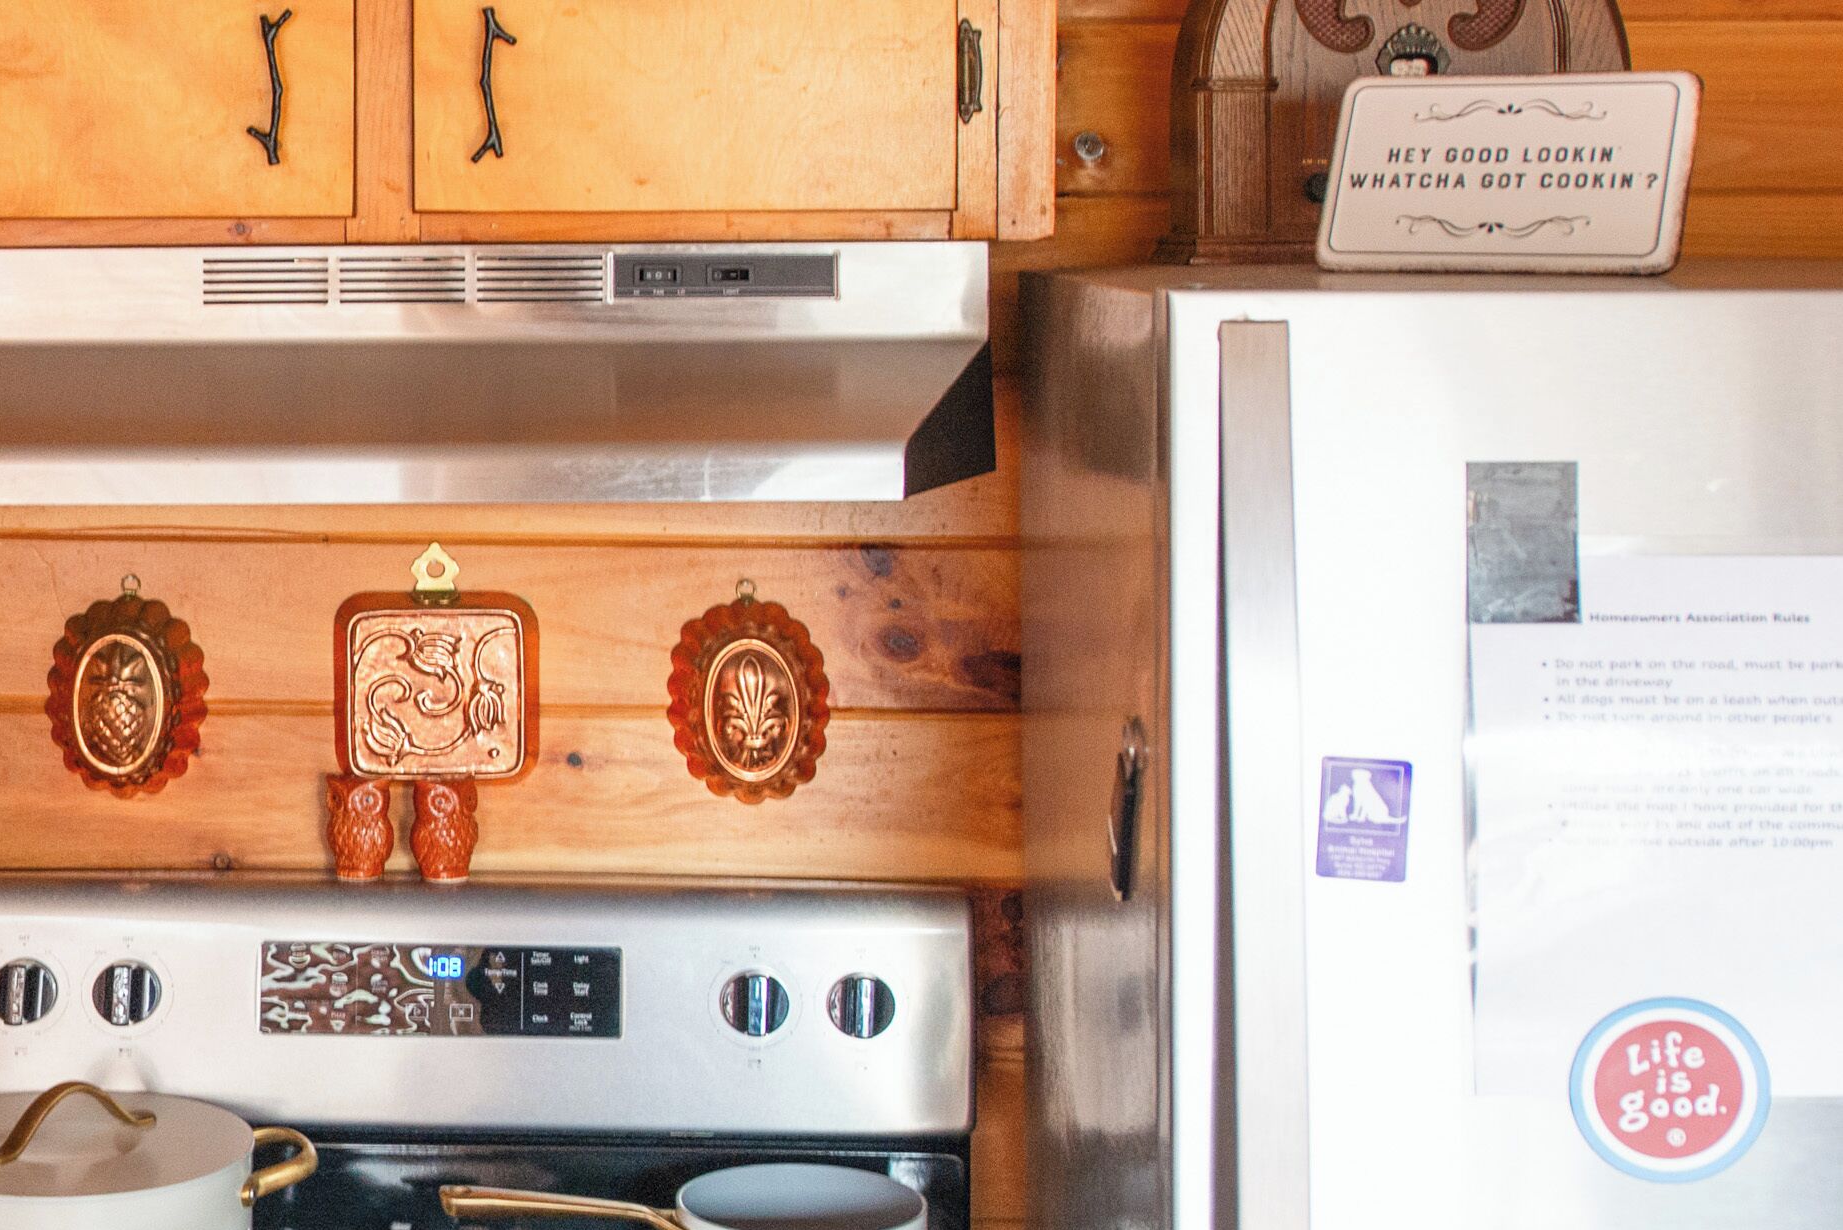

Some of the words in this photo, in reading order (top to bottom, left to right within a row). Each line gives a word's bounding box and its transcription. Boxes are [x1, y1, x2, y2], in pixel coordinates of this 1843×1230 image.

[1387, 146, 1432, 163] HEY
[1444, 146, 1509, 163] GOOD
[1350, 172, 1466, 189] WHATCHA
[1480, 172, 1527, 189] GOT
[1685, 612, 1767, 623] Association
[1773, 612, 1810, 623] Rules
[1555, 659, 1574, 669] Do
[1579, 660, 1603, 669] not
[1609, 659, 1642, 671] park
[1648, 661, 1666, 669] on
[1672, 659, 1695, 669] the
[1745, 660, 1781, 670] must
[1788, 659, 1805, 670] be
[1556, 677, 1570, 686] in
[1575, 677, 1599, 687] the
[1605, 676, 1673, 688] driveway
[1557, 694, 1575, 704] All
[1581, 694, 1613, 706] dogs
[1620, 695, 1656, 705] must
[1663, 694, 1680, 705] be
[1686, 696, 1704, 705] on
[1724, 694, 1762, 705] leash
[1768, 694, 1808, 705] when
[1582, 712, 1606, 722] not
[1650, 712, 1702, 723] around
[1727, 712, 1766, 722] other
[1773, 712, 1833, 725] people's
[1693, 802, 1727, 812] have
[1733, 802, 1797, 813] provided
[1804, 803, 1822, 812] for
[1707, 820, 1731, 830] out
[1738, 820, 1753, 830] of
[1759, 820, 1783, 830] the
[1668, 837, 1723, 848] outside
[1729, 836, 1764, 848] after
[428, 956, 462, 977] 1:08
[1626, 1031, 1706, 1077] Life
[1655, 1068, 1692, 1095] is
[1618, 1083, 1728, 1134] good.
